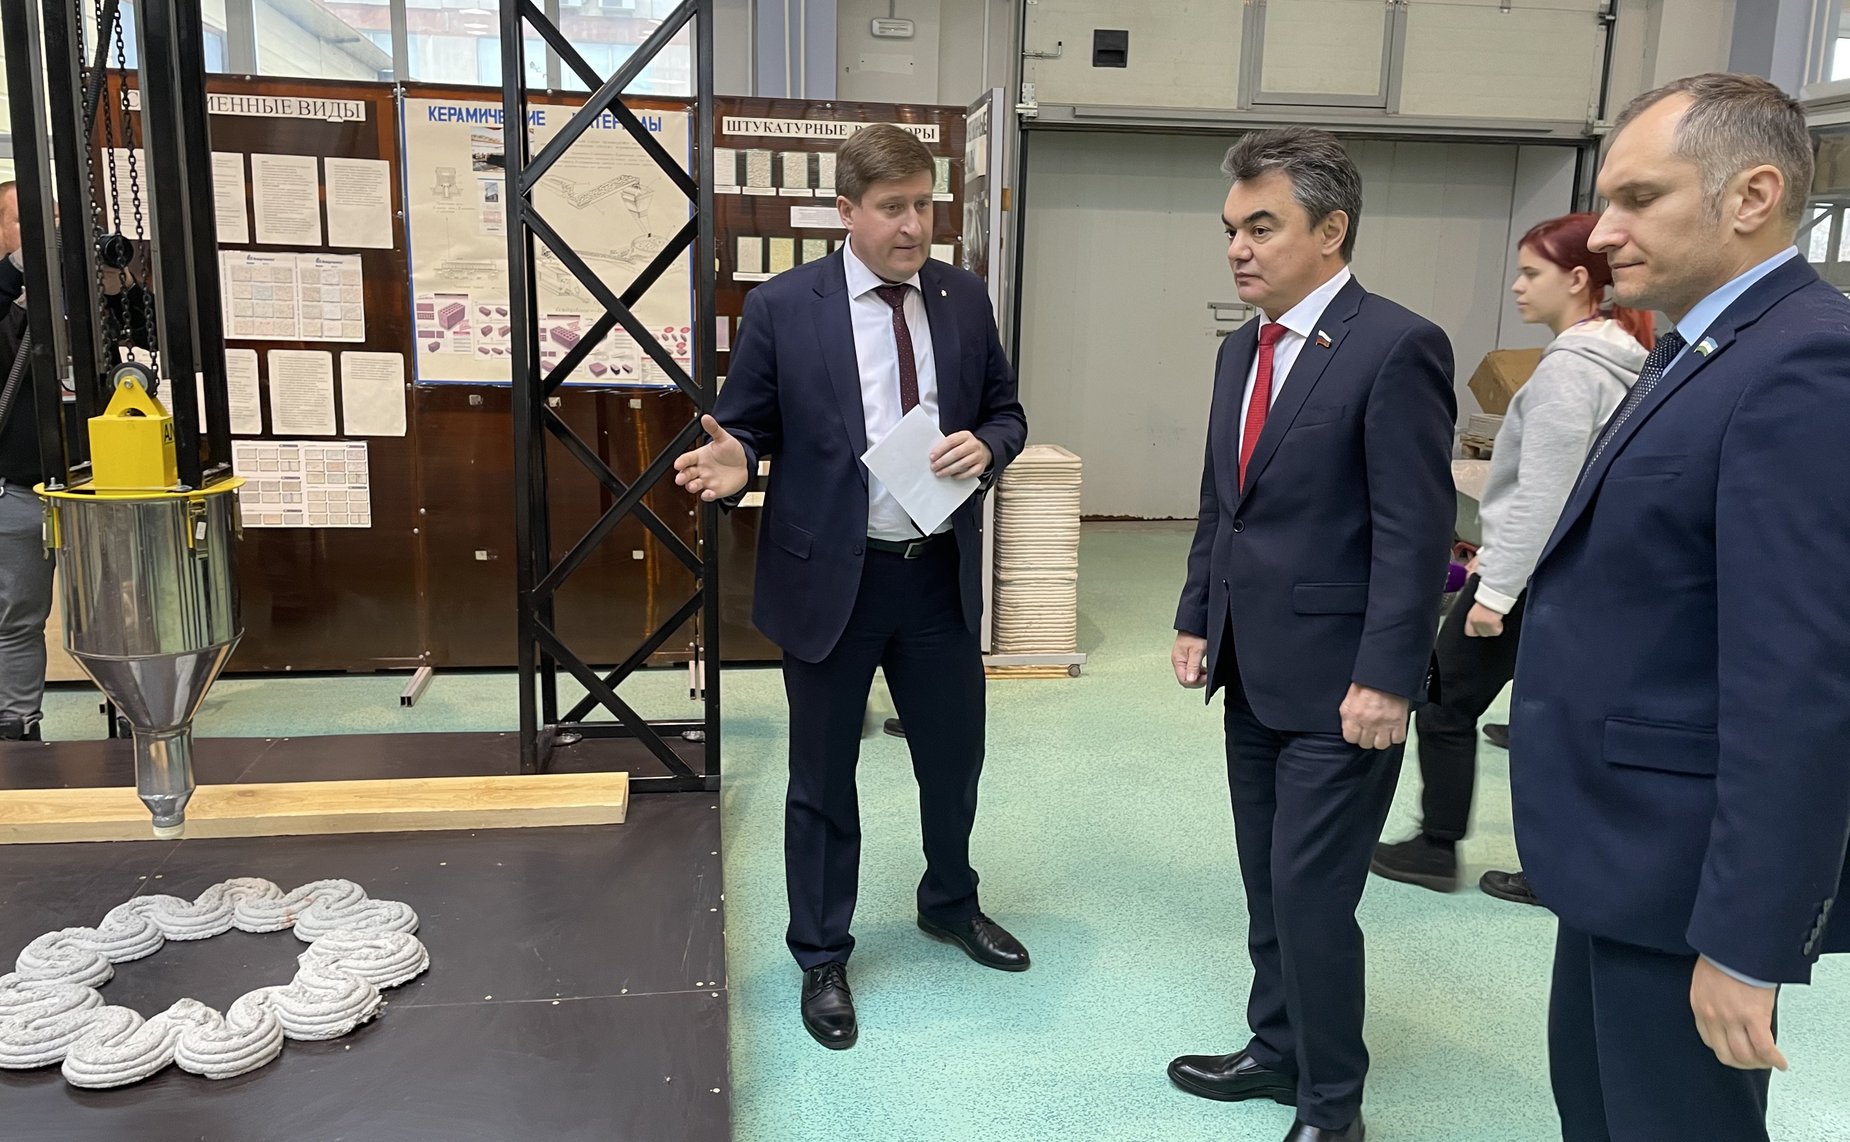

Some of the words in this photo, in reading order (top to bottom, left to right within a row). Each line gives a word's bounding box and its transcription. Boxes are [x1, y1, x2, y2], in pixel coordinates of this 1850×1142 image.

[298, 99, 361, 120] ВИДЫ
[428, 106, 546, 126] КЕРАМИЧЕИЕ
[726, 120, 848, 136] ШТУКАТУРНЫЕ
